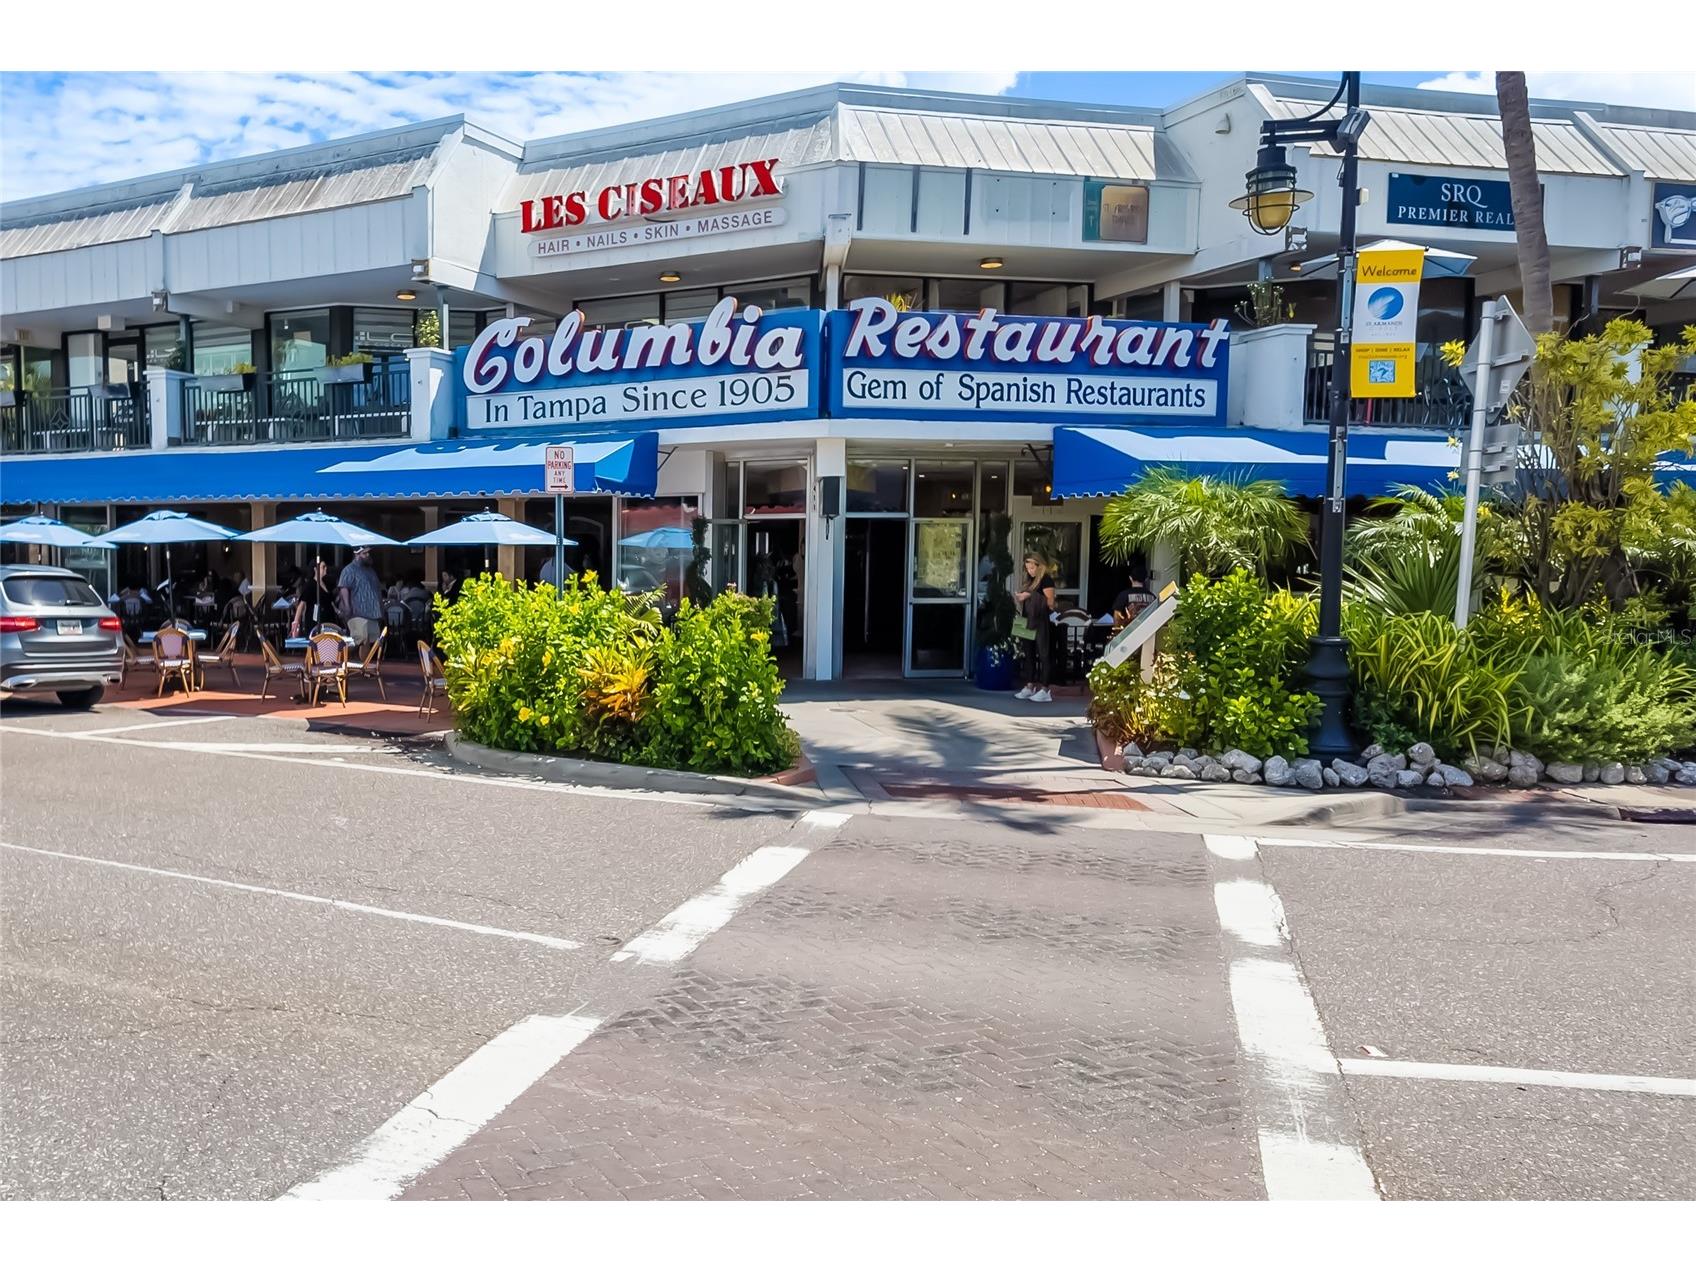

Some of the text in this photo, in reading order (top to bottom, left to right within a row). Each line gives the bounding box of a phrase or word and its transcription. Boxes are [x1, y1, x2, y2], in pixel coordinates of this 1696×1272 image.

[521, 158, 784, 234] LES CISEAUX
[1398, 205, 1469, 223] PREMIER
[1441, 183, 1488, 208] SRQ
[537, 210, 773, 255] HAIR NAILS SKIN MASSAGE
[1362, 265, 1417, 277] Welcome
[462, 296, 804, 394] Columbia
[845, 297, 1230, 369] Restaurant
[485, 375, 795, 423] In Tampa Since 1905
[846, 371, 1206, 409] Gem of Spanish Restaurants
[548, 461, 571, 469] PARKING
[554, 450, 565, 460] NO
